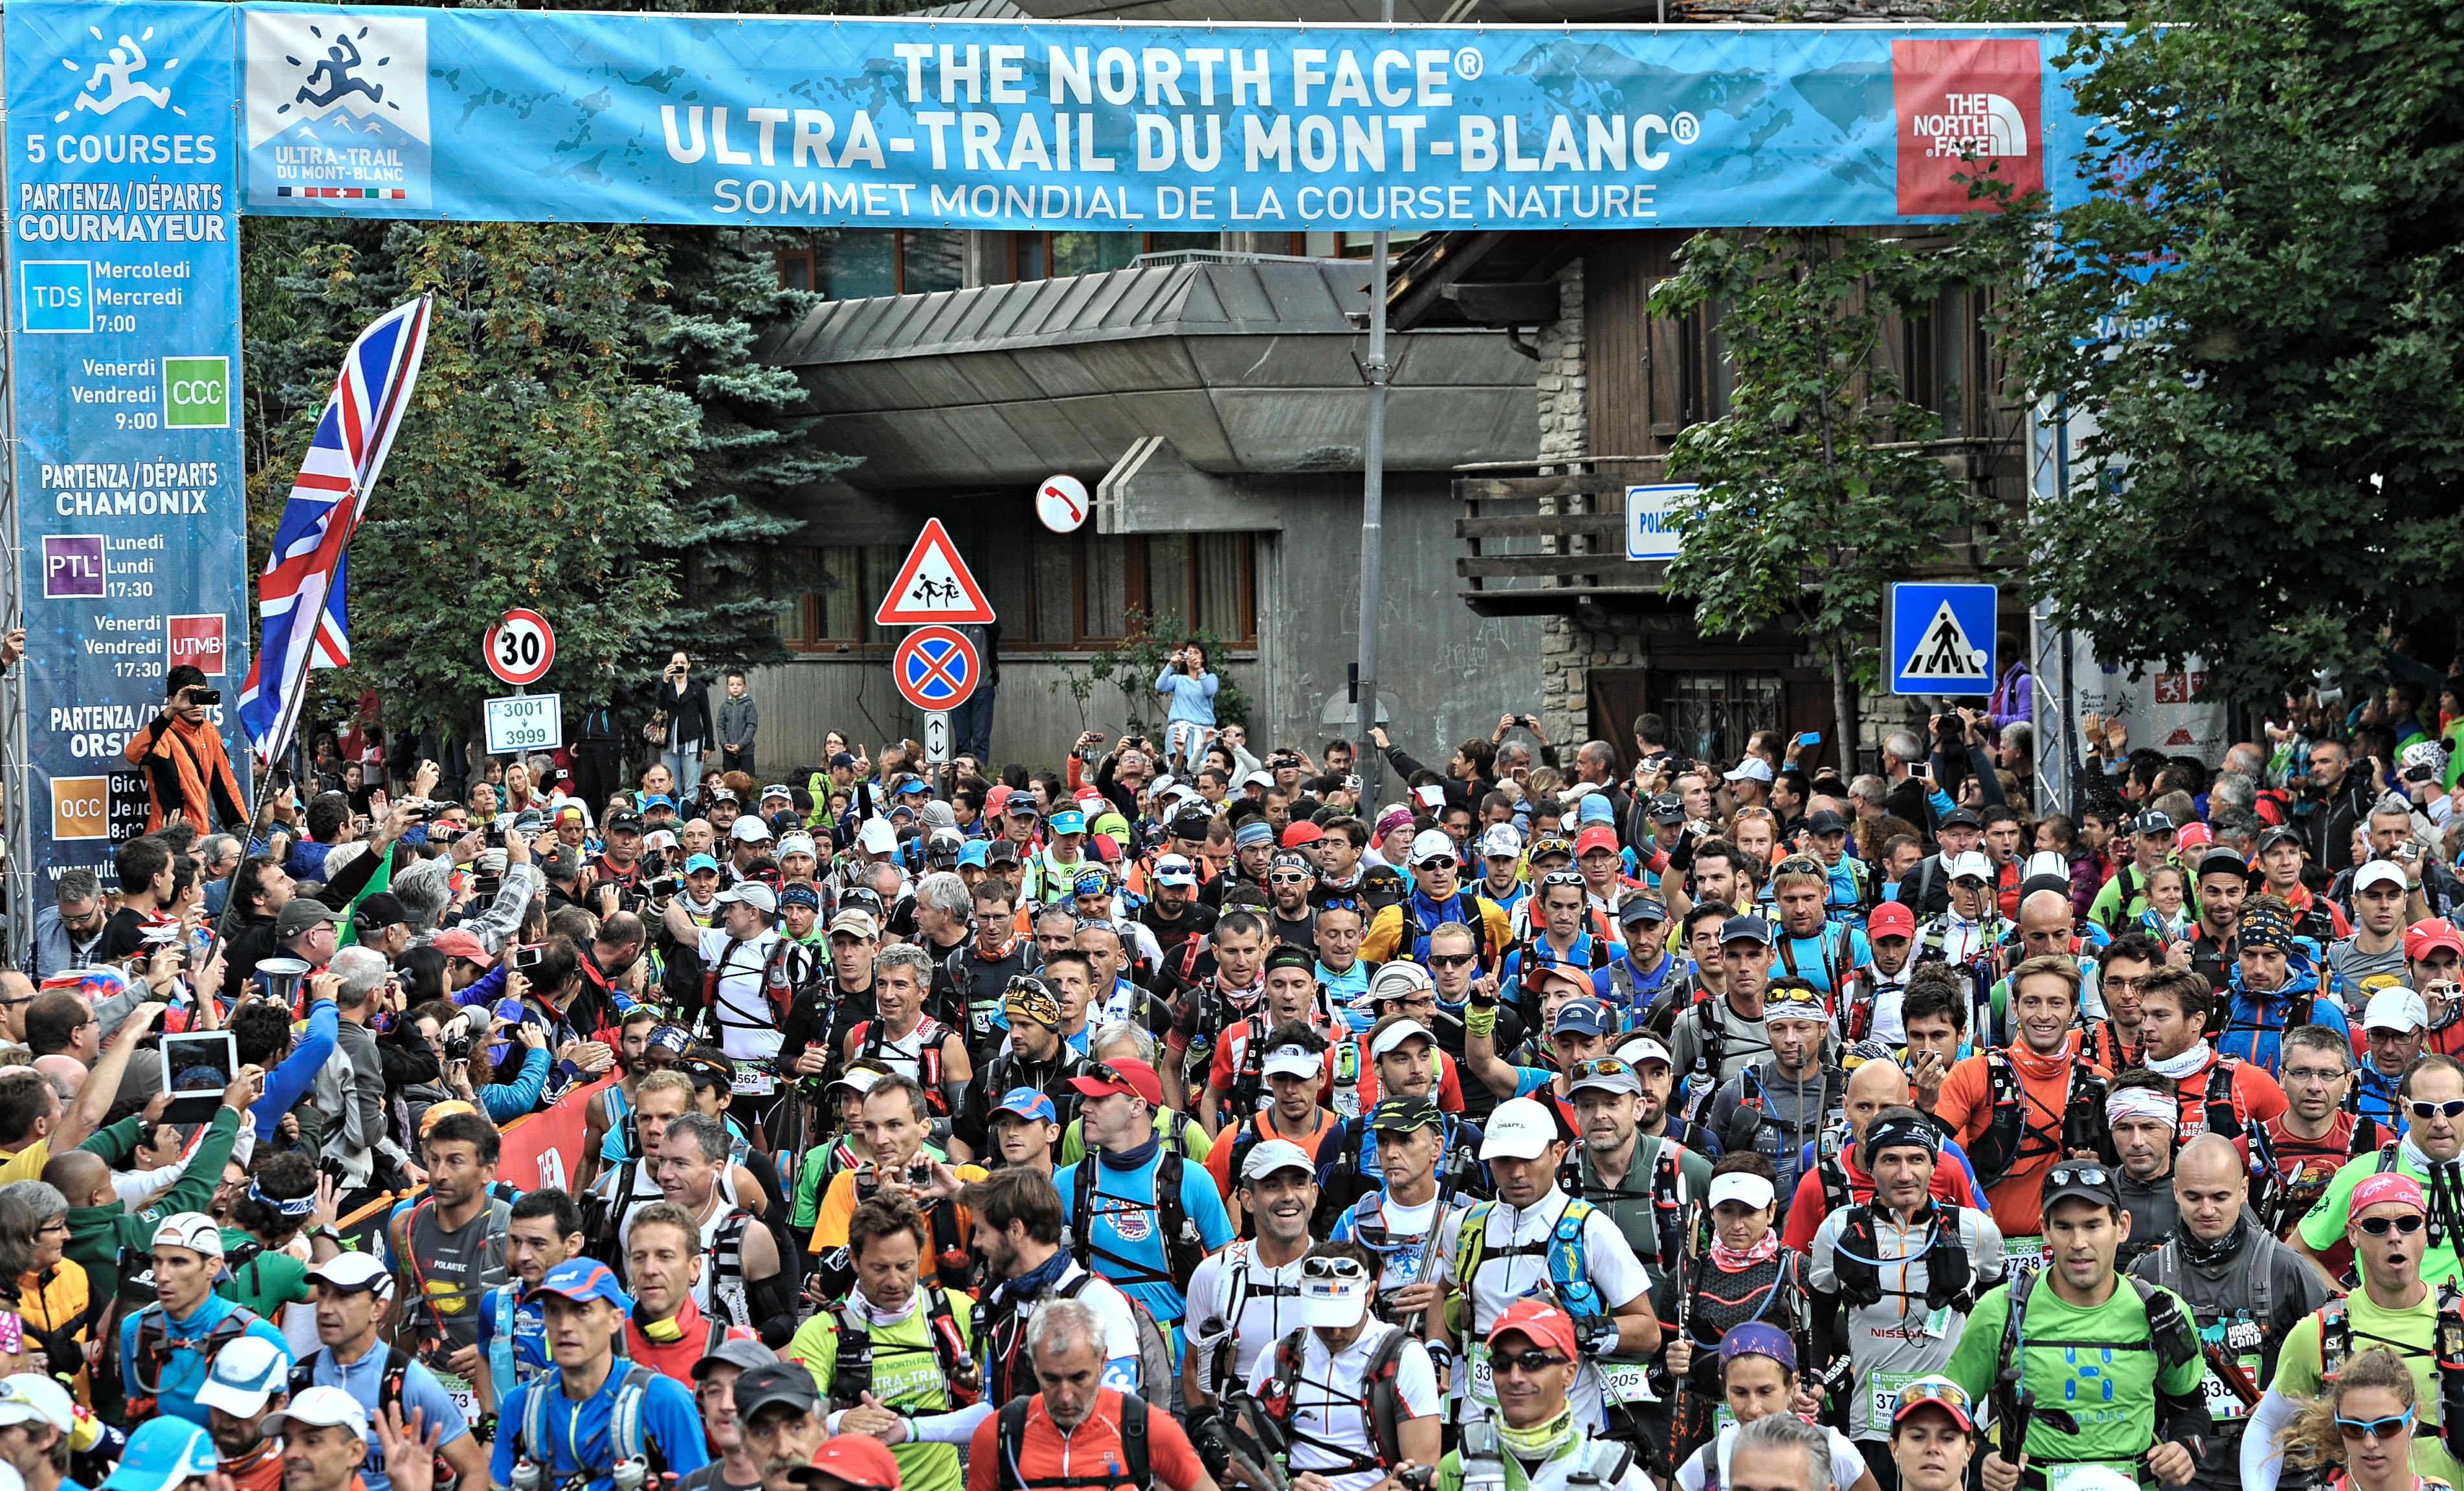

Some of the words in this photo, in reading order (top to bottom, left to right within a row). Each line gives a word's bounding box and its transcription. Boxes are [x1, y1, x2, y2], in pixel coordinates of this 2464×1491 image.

[894, 43, 1025, 104] THE
[1049, 46, 1272, 106] NORTH
[1946, 93, 1987, 115] THE
[1914, 115, 1990, 137] NORTH
[660, 104, 1116, 172] ULTRA-TRAIL
[1137, 112, 1223, 173] DU
[27, 135, 46, 164] 5
[57, 134, 217, 164] COURSES
[276, 146, 404, 167] ULTRA-TRAIL
[276, 166, 298, 179] DU
[301, 166, 404, 182] MONT-BLANC
[19, 174, 223, 212] PARTENZA/DÉPARTS
[712, 179, 916, 217] SOMMET
[931, 183, 1144, 220] MONDIAL
[1157, 185, 1216, 221] DE
[1230, 186, 1285, 220] LA
[1296, 184, 1474, 221] COURSE
[1487, 184, 1658, 219] NATURE
[17, 214, 227, 243] COURMAYEUR
[95, 261, 191, 279] Mercoledi
[32, 285, 83, 308] TDS
[96, 287, 183, 305] Mercredi
[96, 315, 136, 333] 7:00
[82, 359, 157, 377] Venerdi
[71, 385, 157, 404] Vendredi
[172, 379, 222, 405] CCC
[115, 412, 158, 430] 9:00
[41, 455, 217, 489] PARTENZA/DÉPARTS
[56, 489, 208, 516] CHAMONIX
[105, 534, 164, 551] Lunedi
[49, 553, 99, 578] PTL
[107, 558, 154, 574] Lundi
[107, 582, 153, 598] 17:30
[94, 615, 161, 632] Venerdi
[84, 639, 162, 655] Vendredi
[173, 636, 221, 655] UTMB
[501, 629, 541, 666] 30
[115, 662, 162, 678] 17:30
[504, 701, 544, 718] 3001
[505, 728, 546, 746] 3999
[61, 798, 101, 818] OCC
[2016, 1245, 2037, 1255] CCC
[434, 1259, 469, 1273] POLARTEC
[1870, 1328, 1928, 1339] NISSAN
[874, 1364, 885, 1372] HE
[1617, 1364, 1640, 1373] CCC
[874, 1367, 942, 1390] TRA-TRA
[1876, 1393, 1897, 1410] 37
